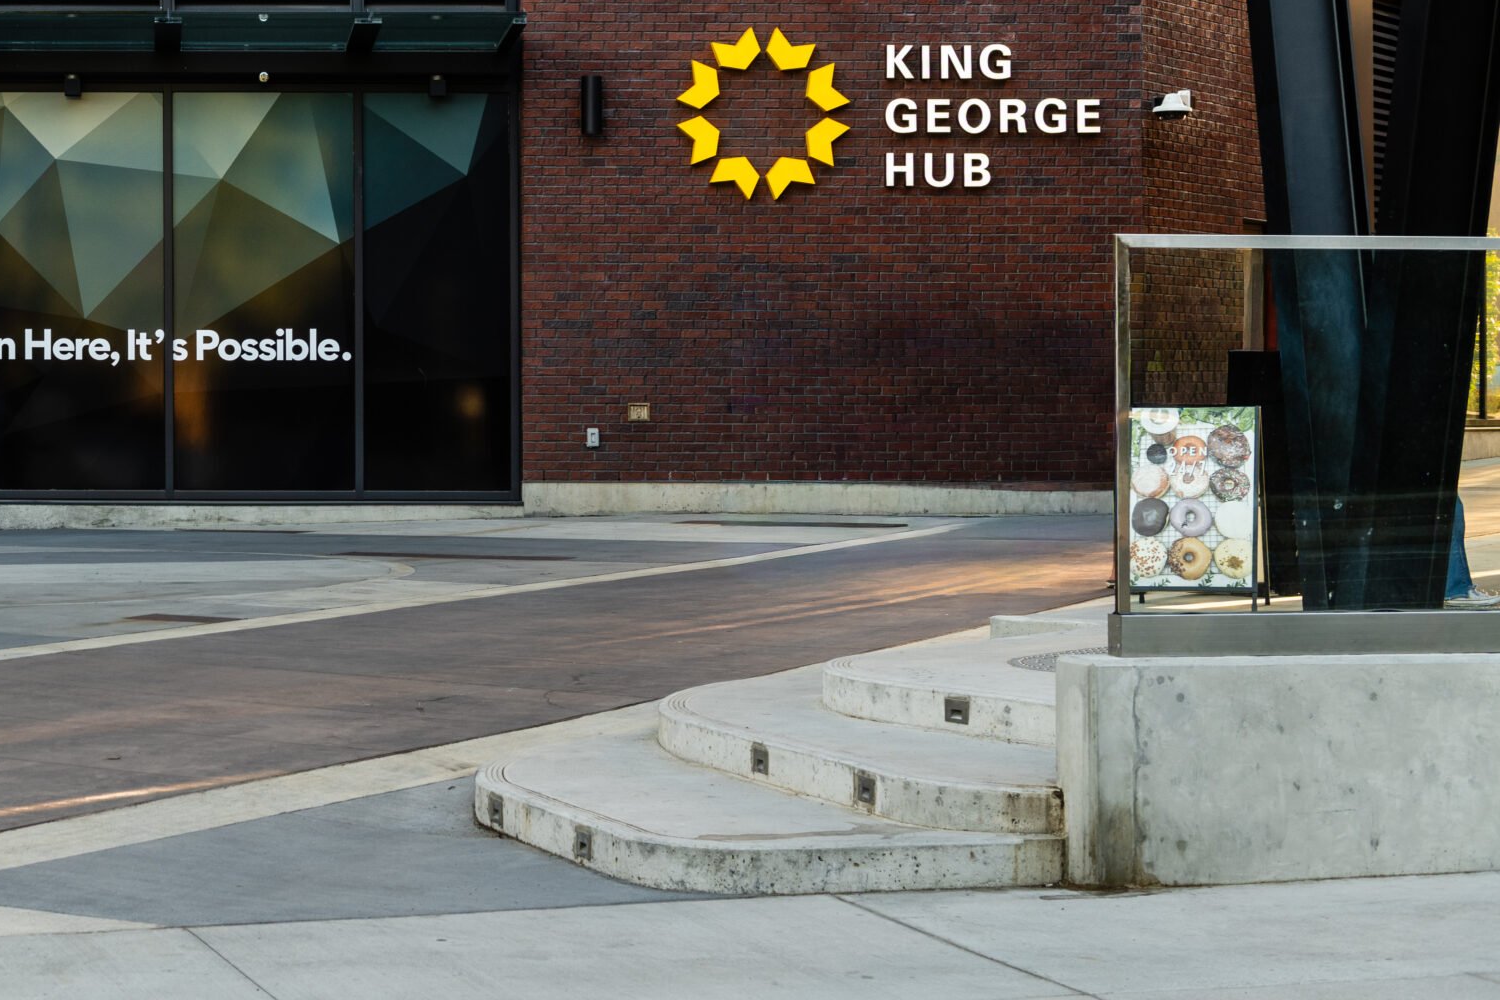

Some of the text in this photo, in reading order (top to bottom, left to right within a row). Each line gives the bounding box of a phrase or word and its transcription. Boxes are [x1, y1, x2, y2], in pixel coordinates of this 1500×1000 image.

[885, 43, 1012, 80] KING
[885, 97, 1102, 134] GEORGE
[885, 152, 992, 188] HUB
[24, 328, 121, 367] Here,
[195, 328, 352, 361] Possible.
[1167, 446, 1208, 457] OPEN
[1169, 460, 1206, 476] 24/7
